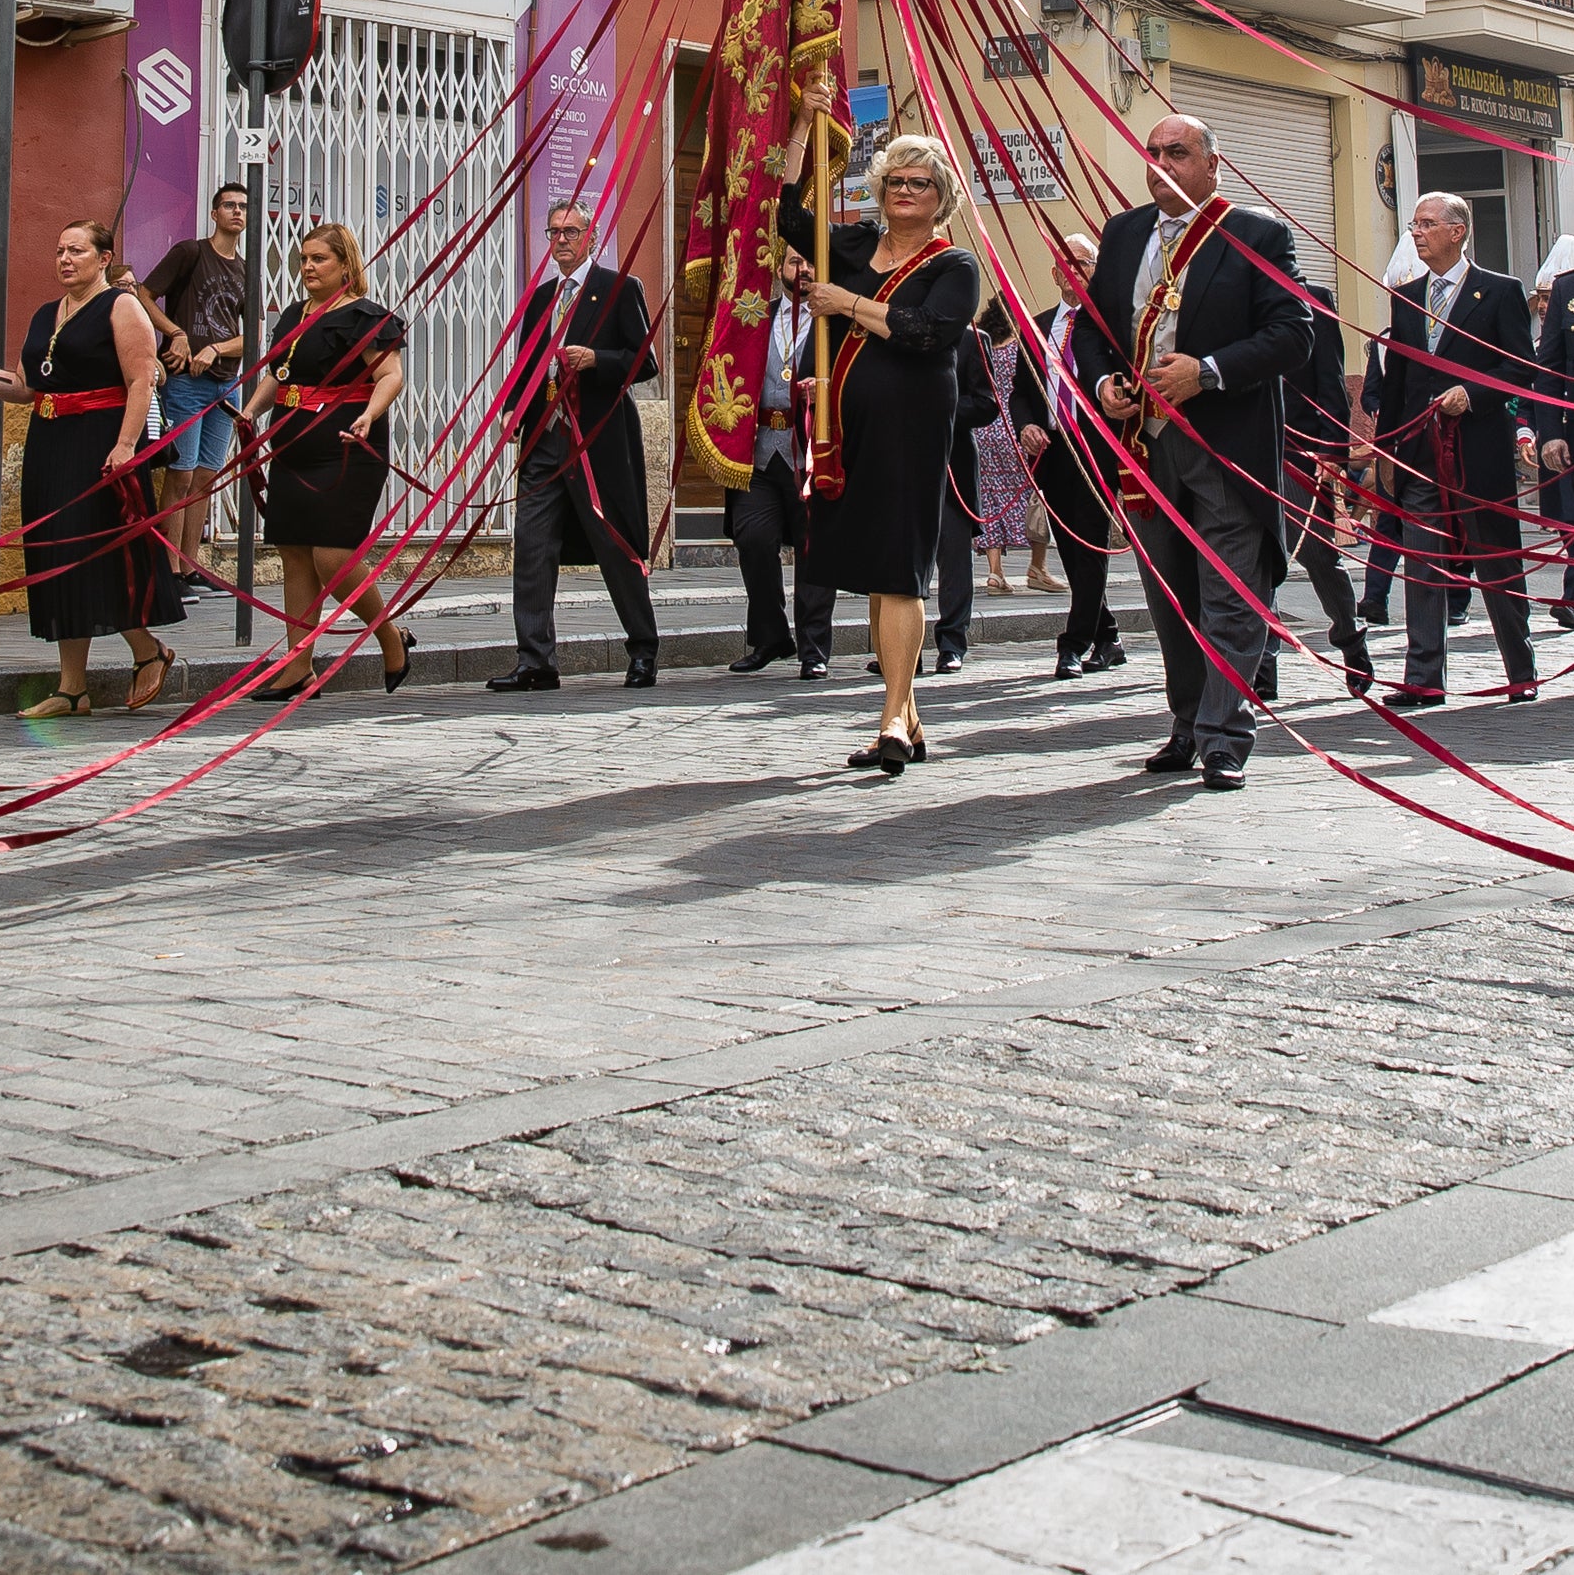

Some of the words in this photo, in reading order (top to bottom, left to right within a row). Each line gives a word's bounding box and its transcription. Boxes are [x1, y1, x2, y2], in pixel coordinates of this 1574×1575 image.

[990, 58, 1043, 74] TRIAA
[550, 74, 608, 97] SICCIONA
[1451, 64, 1506, 97] PANADERÍA
[1513, 79, 1558, 108] BOLLERÍA
[1460, 95, 1470, 111] EL
[1471, 96, 1497, 118] RINCÓN
[1498, 102, 1509, 118] DE
[1509, 105, 1531, 124] SANTA
[1531, 110, 1553, 129] JUSTA
[1049, 130, 1062, 144] LA
[194, 311, 204, 324] TO
